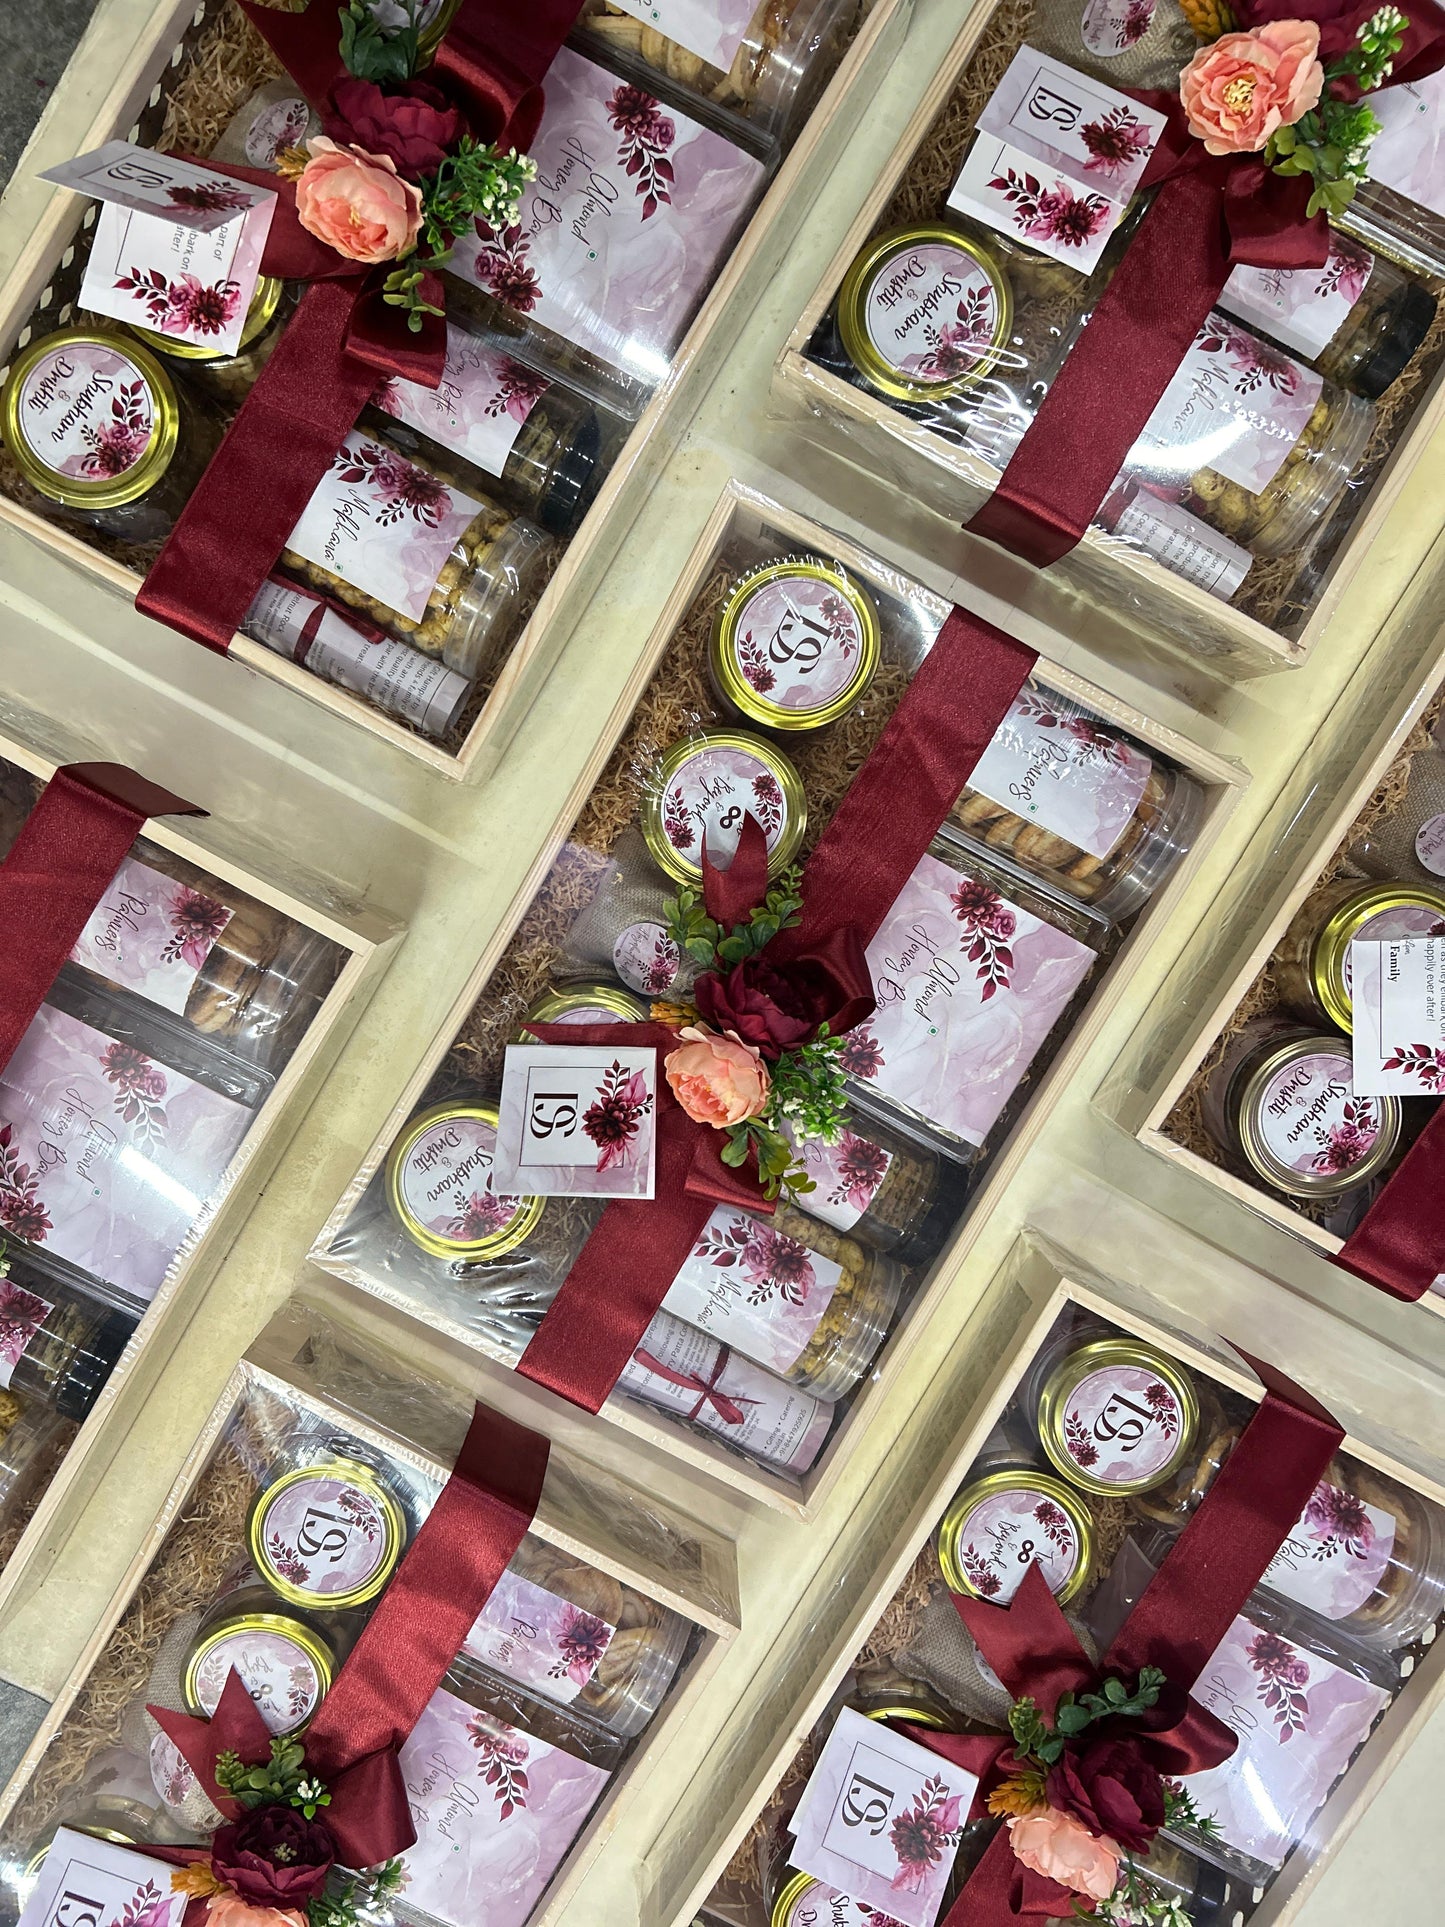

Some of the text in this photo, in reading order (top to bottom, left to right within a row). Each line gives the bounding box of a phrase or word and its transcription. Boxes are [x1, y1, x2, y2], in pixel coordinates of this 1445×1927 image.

[525, 137, 596, 238] Honey Bar
[571, 173, 619, 246] Almond
[180, 257, 190, 270] on
[213, 249, 222, 261] of
[876, 255, 926, 312] Drishti
[894, 272, 962, 340] Shubham
[28, 356, 75, 414] Drishti
[51, 370, 113, 443] Shubham
[58, 389, 71, 402] &
[429, 380, 463, 415] Patta
[1174, 358, 1229, 431] Makhana
[325, 489, 377, 560] Makhana
[276, 614, 290, 632] Rock
[1009, 736, 1070, 802] Palmiers
[688, 776, 735, 830] Beyond
[94, 891, 150, 952] Palmiers
[884, 925, 939, 974] Honey
[1387, 946, 1400, 982] Family
[914, 953, 960, 1022] Almond
[1426, 974, 1434, 994] ever
[1426, 996, 1436, 1022] after!
[1269, 1065, 1312, 1119] Drishti
[1287, 1078, 1347, 1143] Shubham
[36, 1088, 94, 1177] Honey Bar
[76, 1116, 118, 1184] Almond
[412, 1127, 462, 1175] Drishti
[427, 1145, 493, 1202] Shubham
[697, 1272, 748, 1324] Makhana
[671, 1338, 684, 1358] Patta
[984, 1521, 1021, 1569] Beyond
[488, 1616, 539, 1668] Palmiers
[407, 1753, 458, 1799] Honey
[437, 1778, 480, 1841] Almond
